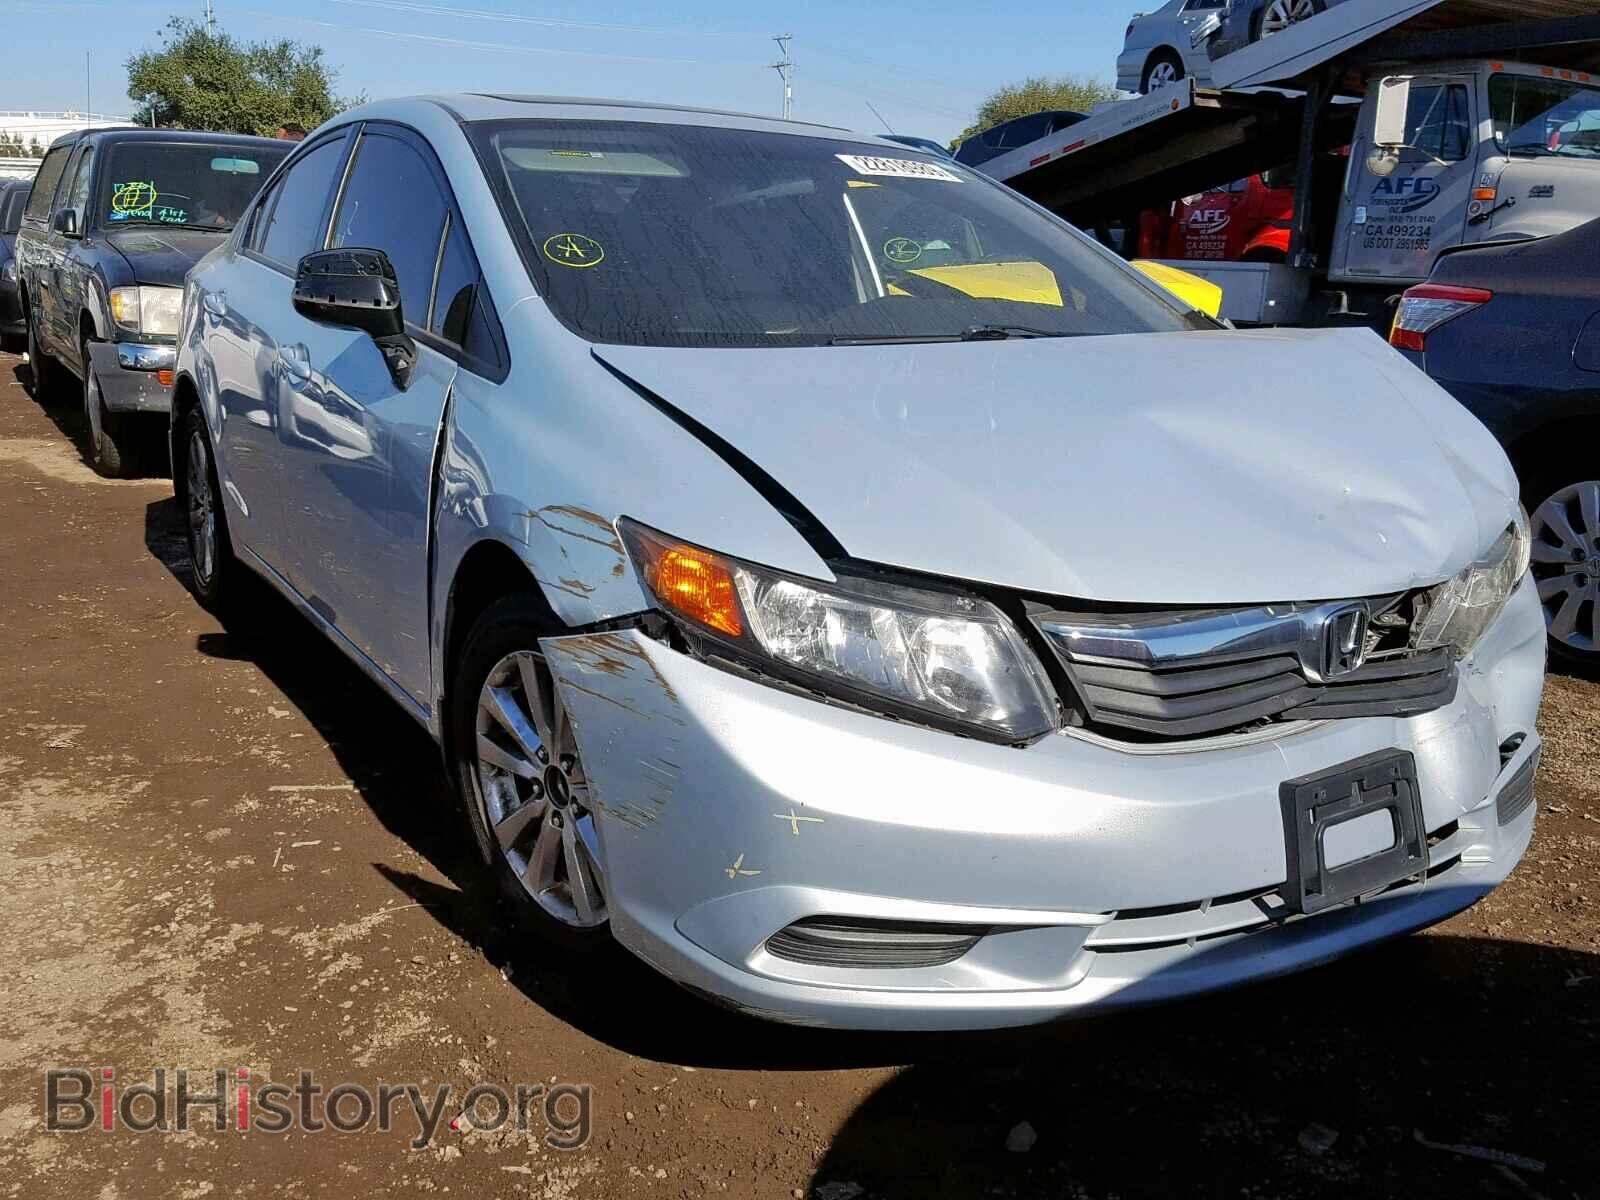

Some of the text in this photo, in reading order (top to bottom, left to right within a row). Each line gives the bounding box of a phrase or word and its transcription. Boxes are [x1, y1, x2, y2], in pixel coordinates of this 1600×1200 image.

[1371, 177, 1434, 194] AFC
[1190, 210, 1227, 221] AFC
[1366, 225, 1432, 237] CA 499234
[1362, 237, 1375, 249] US
[1376, 238, 1393, 249] DOT
